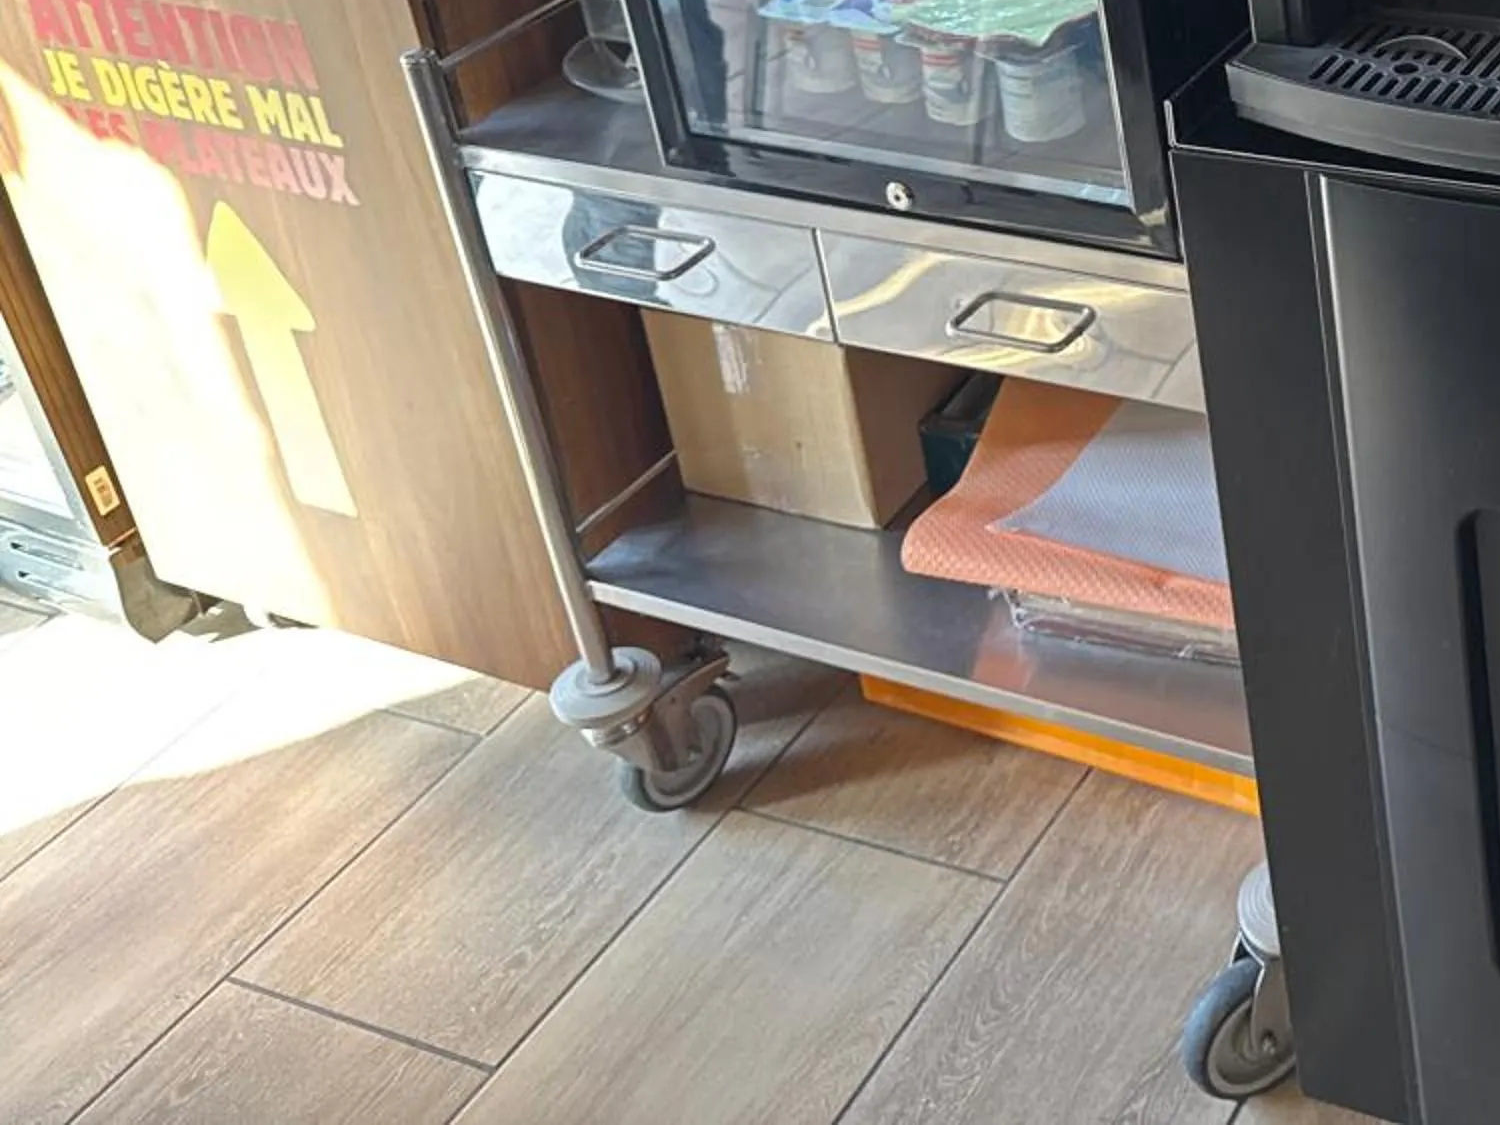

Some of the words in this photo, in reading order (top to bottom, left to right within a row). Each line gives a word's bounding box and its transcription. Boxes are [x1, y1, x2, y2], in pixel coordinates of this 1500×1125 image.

[44, 48, 93, 101] JE
[91, 57, 244, 130] DIGÈRE
[245, 83, 344, 148] MAL
